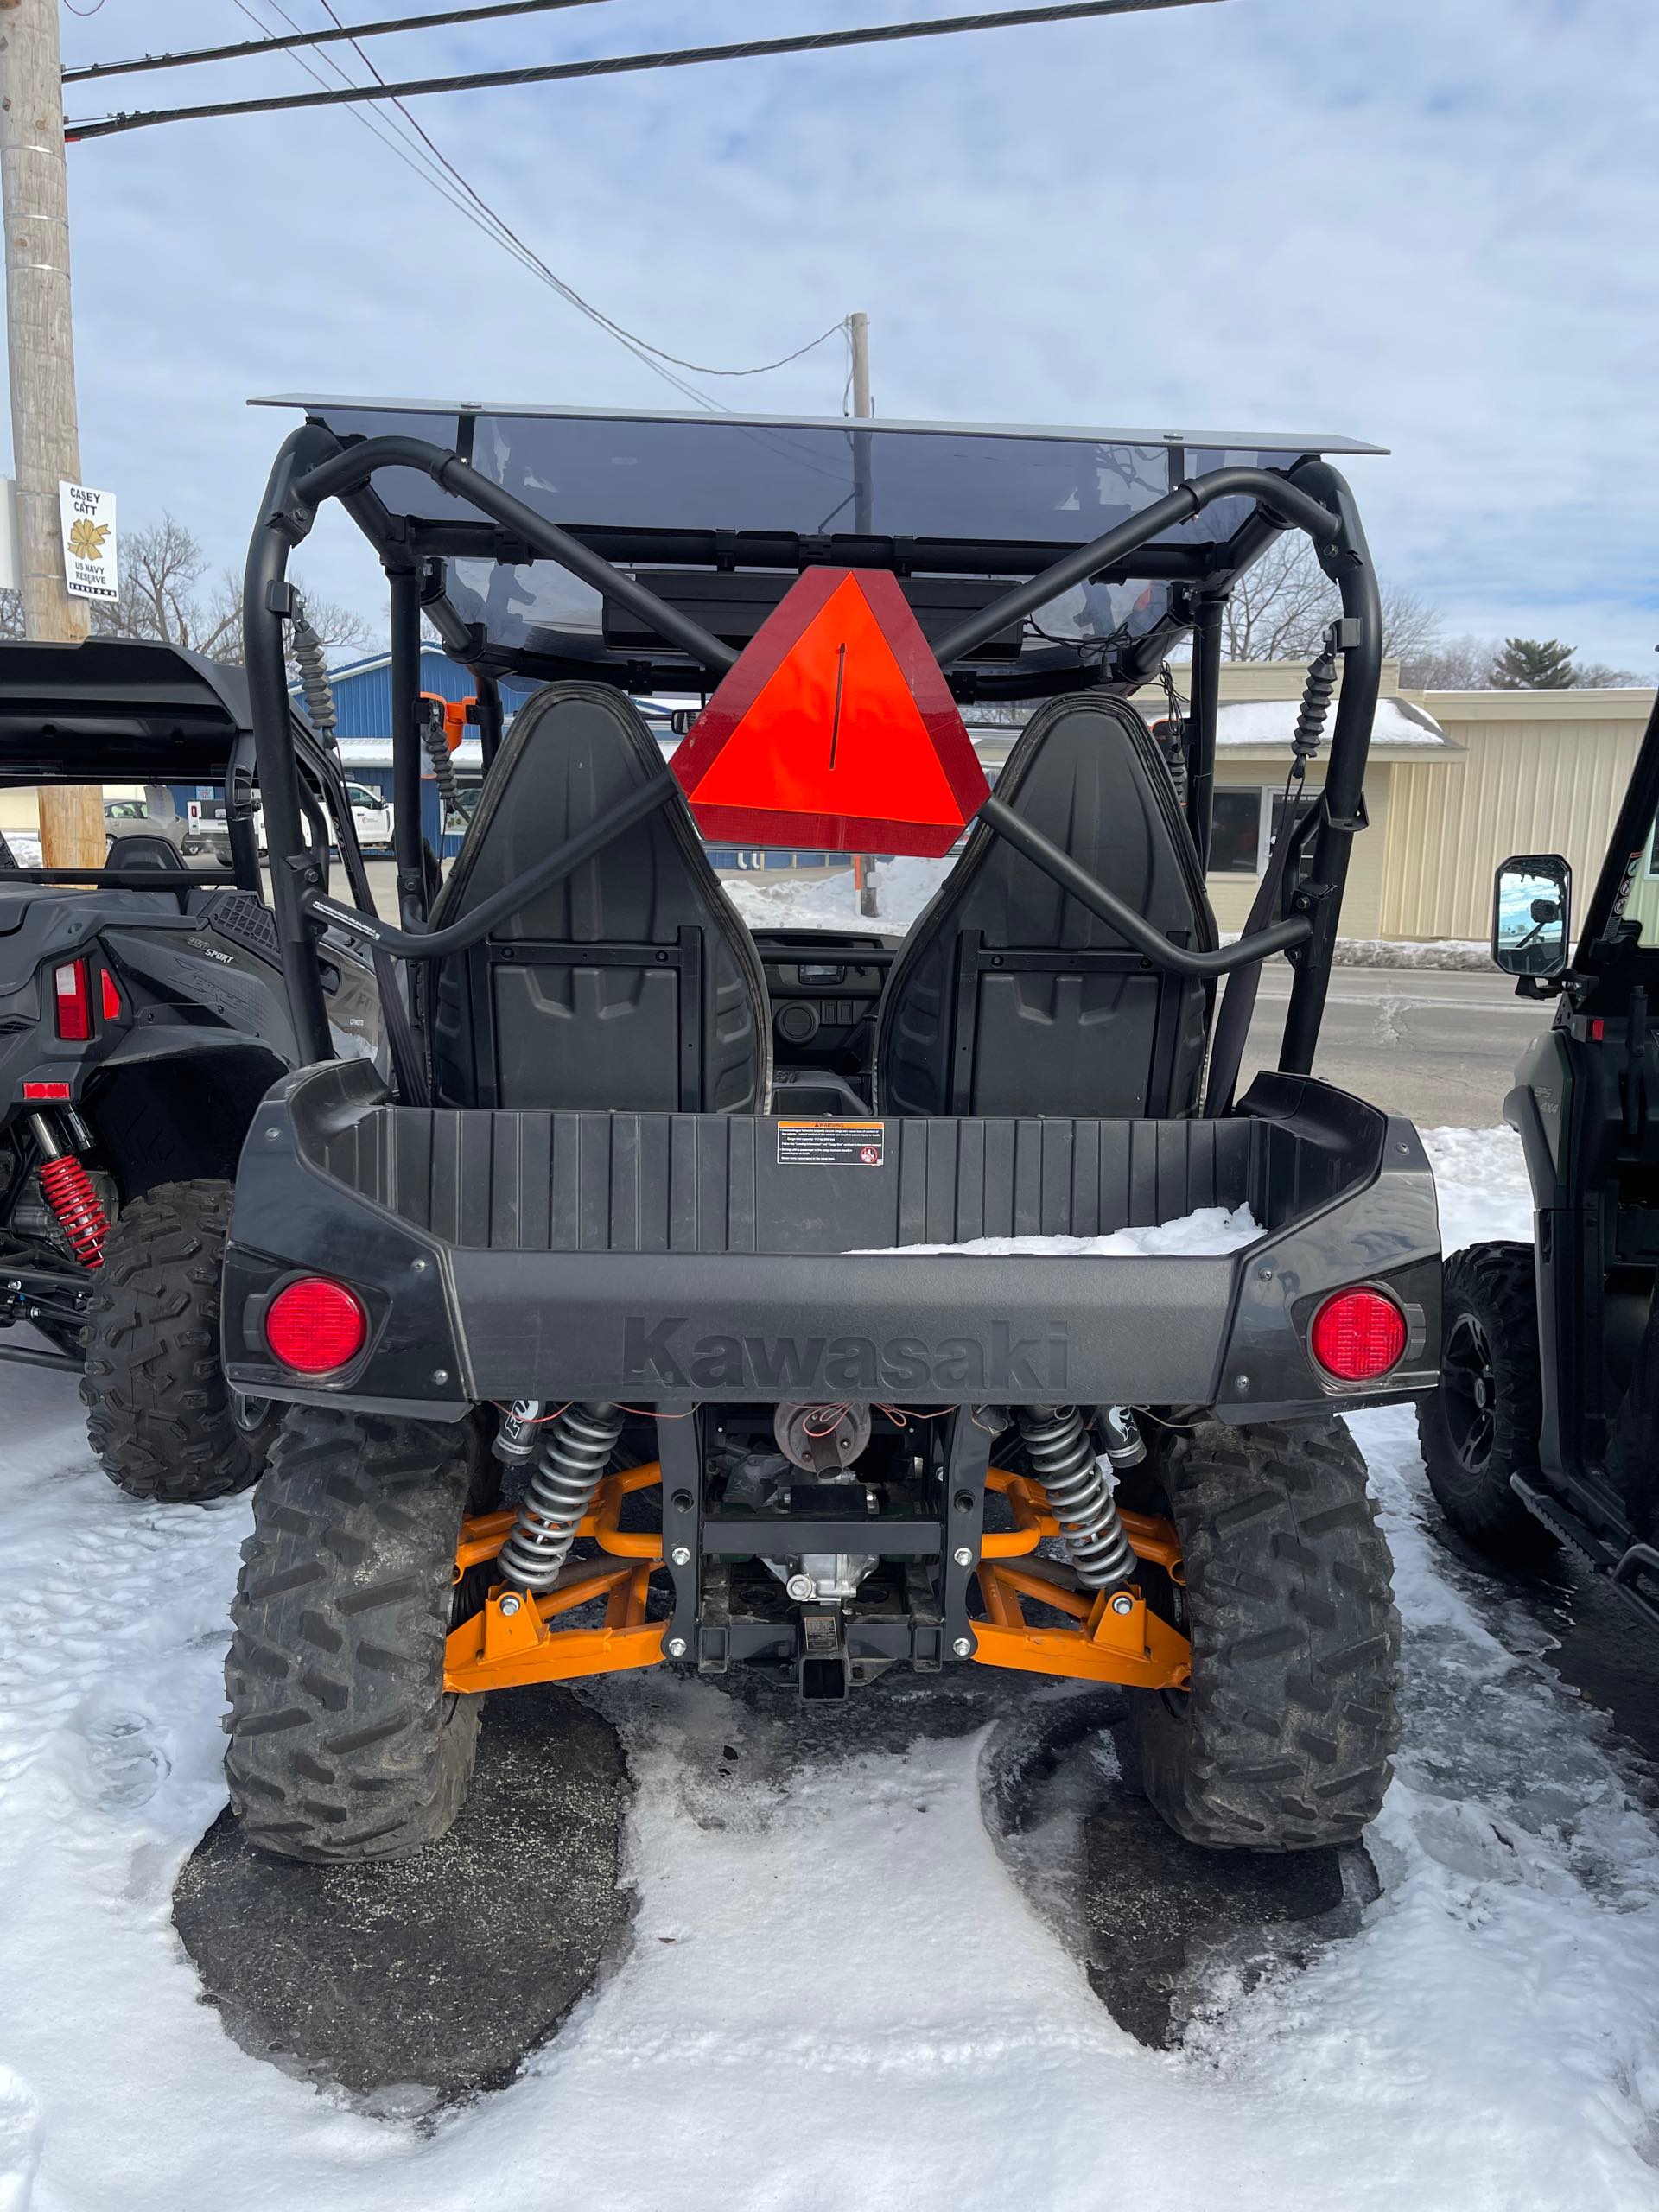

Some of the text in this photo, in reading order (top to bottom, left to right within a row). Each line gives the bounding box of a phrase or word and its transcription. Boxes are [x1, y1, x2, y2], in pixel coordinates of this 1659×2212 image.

[70, 487, 101, 504] CASEY
[74, 501, 97, 516] CATT
[75, 562, 105, 575] US NAVY
[75, 572, 106, 584] RESERVE
[205, 949, 234, 963] SPORT
[623, 1316, 1070, 1391] Kawasaki
